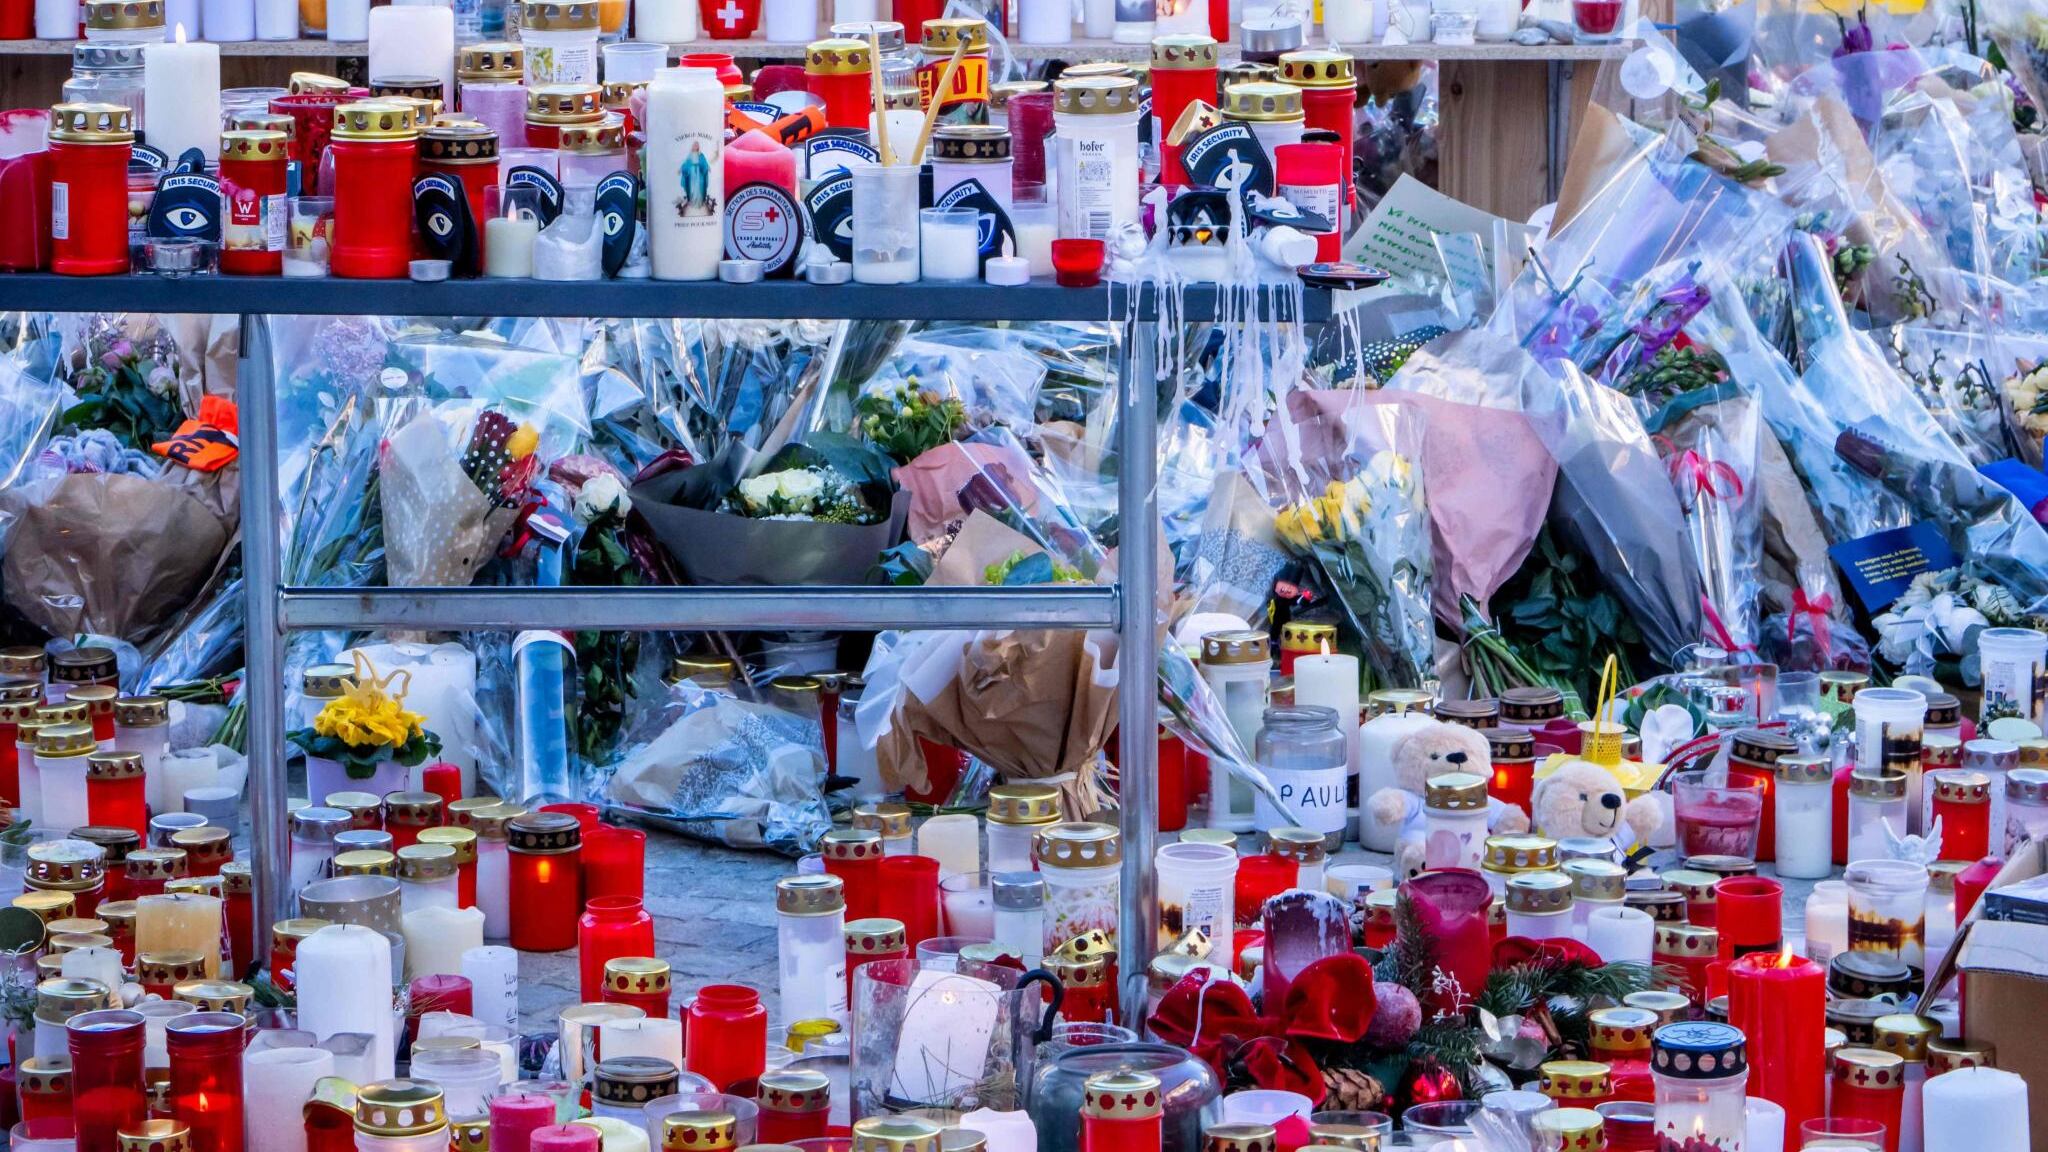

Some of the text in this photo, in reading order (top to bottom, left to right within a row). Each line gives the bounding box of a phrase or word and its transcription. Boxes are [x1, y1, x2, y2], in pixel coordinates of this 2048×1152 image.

[813, 139, 873, 160] IRIS SECURITY
[1080, 141, 1105, 152] hofer
[1189, 128, 1243, 163] IRIS SECURITY
[167, 177, 221, 193] IRIS SECURI
[425, 179, 452, 194] SECURITY
[512, 172, 556, 198] IRIS SECURITY
[726, 188, 794, 219] SECTION DES SAMARITAINS
[812, 190, 831, 206] IRIS
